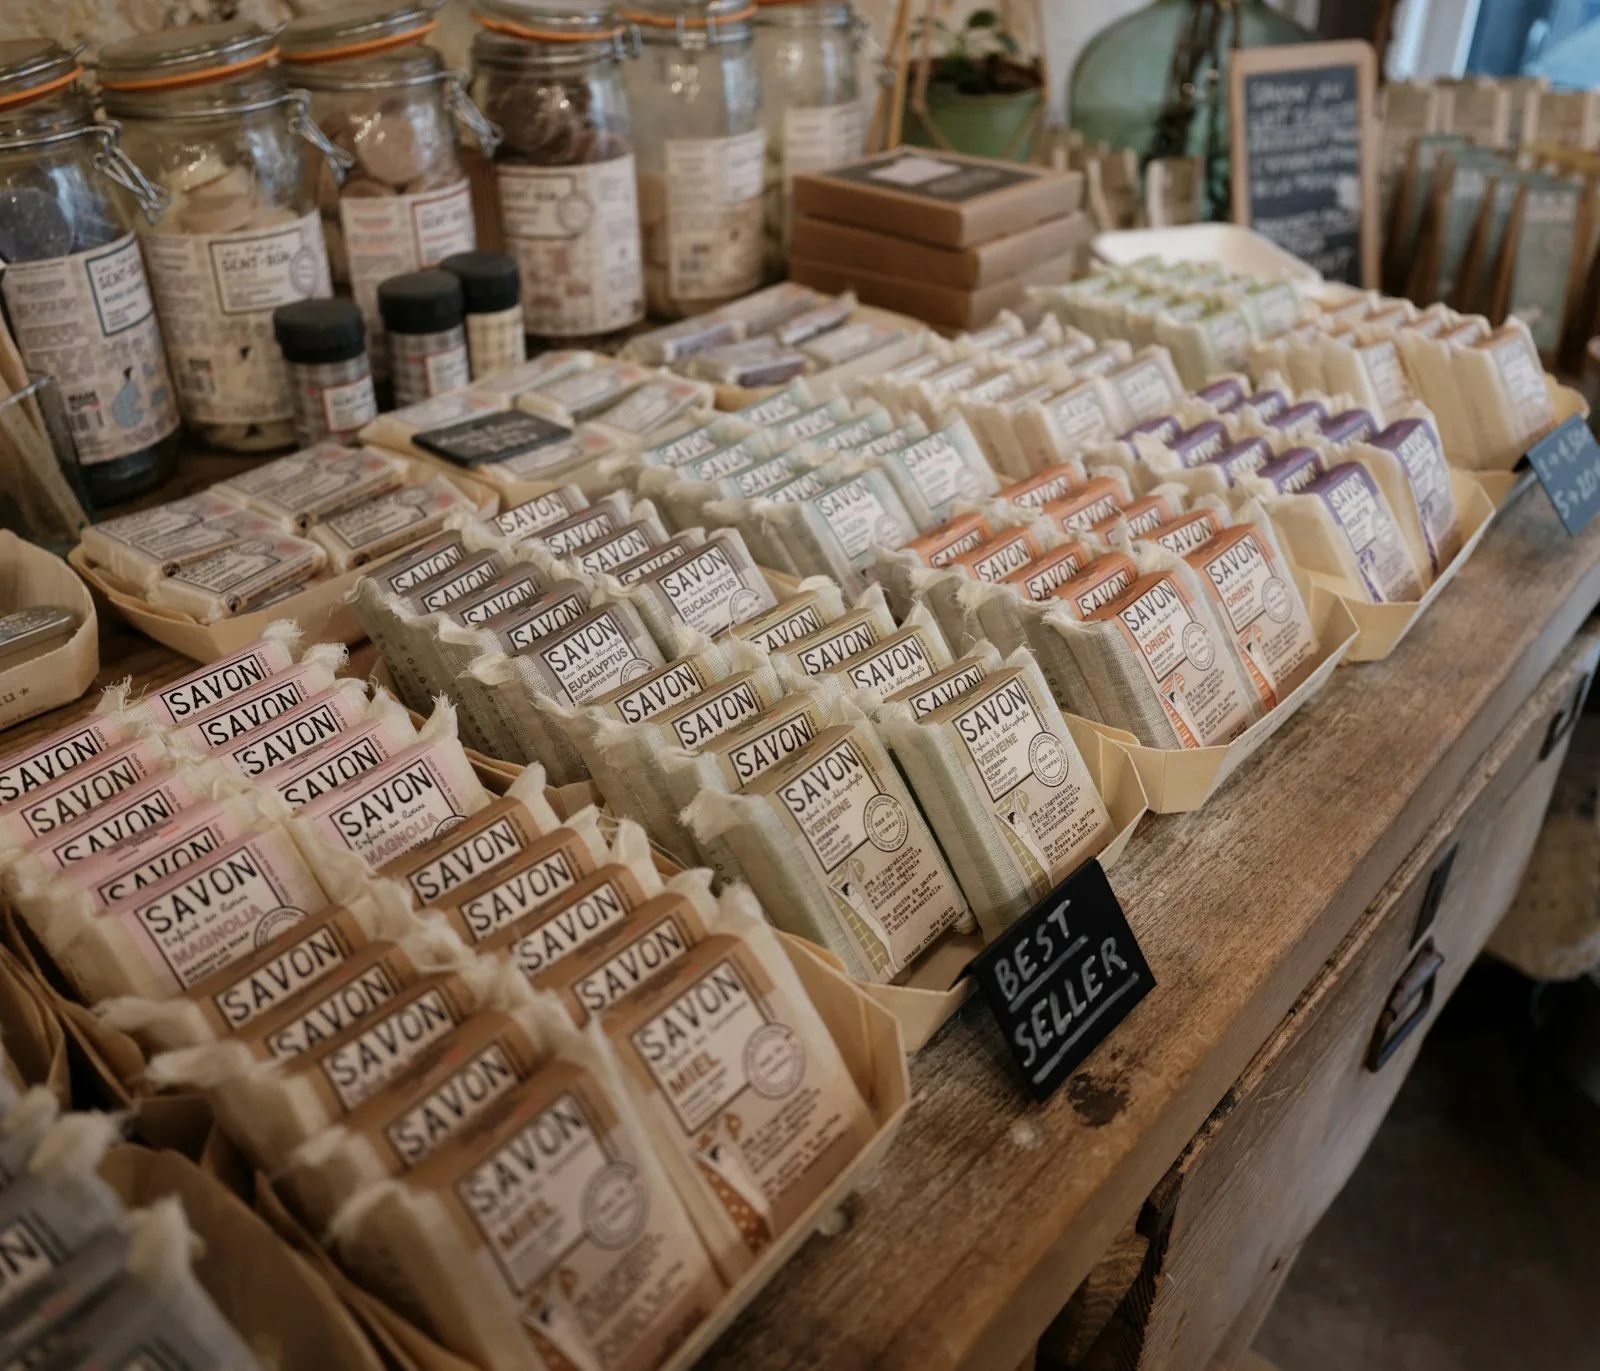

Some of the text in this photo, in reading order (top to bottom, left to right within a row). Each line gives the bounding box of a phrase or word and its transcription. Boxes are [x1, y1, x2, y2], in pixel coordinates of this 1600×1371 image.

[903, 432, 951, 468] SAVON
[739, 458, 790, 494] SAVON
[819, 477, 870, 517] SAVON
[1328, 472, 1367, 511] SAVON
[499, 493, 564, 533] SAVON
[549, 517, 614, 556] SAVON
[1066, 501, 1117, 532] SAVON
[1162, 519, 1213, 554] SAVON
[582, 530, 647, 575] SAVON
[663, 550, 728, 598] SAVON
[978, 541, 1029, 583] SAVON
[1209, 538, 1260, 586] SAVON
[681, 578, 738, 618] EUCALYPTUS
[1029, 558, 1079, 601] SAVON
[1080, 572, 1130, 617] SAVON
[1227, 579, 1255, 607] ORIENT
[514, 602, 583, 645] SAVON
[1123, 581, 1176, 632] SAVON
[548, 617, 618, 672] SAVON
[754, 611, 818, 653] AVON
[805, 627, 873, 675] SAVON
[1144, 624, 1174, 655] ORIENT
[169, 660, 261, 715] SAVON
[567, 647, 628, 694] EUCALYPTUS
[574, 666, 620, 701] EUCALYPTUS SOAP
[855, 640, 923, 690] SAVON
[207, 687, 297, 746] SAVON
[623, 665, 696, 724] SAVON
[680, 687, 755, 747] SAVON
[959, 683, 1026, 743] SAVON
[242, 710, 336, 775] SAVON
[736, 719, 812, 778] SAVON
[977, 733, 1018, 767] VERVEINE
[983, 756, 1008, 775] VERBENA
[1038, 748, 1056, 763] mas du
[1042, 757, 1061, 773] roseau
[0, 735, 96, 802] SAVON
[284, 744, 378, 805] SAVON
[784, 745, 860, 813] SAVON
[987, 769, 1002, 782] SOAP
[31, 763, 136, 834] SAVON
[338, 766, 433, 837] SAVON
[807, 798, 852, 838] VERVEINE
[874, 810, 894, 828] mas du
[1057, 786, 1081, 807] naturelle
[64, 797, 170, 861] SAVON
[355, 829, 387, 850] Infusé
[389, 818, 400, 829] au
[364, 812, 440, 866] MAGNOLIA
[814, 824, 840, 846] VERBENA
[818, 836, 834, 852] SOAP
[1042, 815, 1057, 828] huile
[1043, 844, 1053, 853] Une
[1079, 808, 1095, 826] parfum
[416, 824, 516, 900] SAVON
[145, 854, 257, 934] SAVON
[468, 857, 571, 933] SAVON
[172, 903, 265, 966] MAGNOLIA
[228, 931, 250, 951] SOAP
[518, 888, 620, 971] SAVON
[993, 899, 1072, 1001] BEST
[224, 933, 338, 1022] SAVON
[581, 924, 683, 1011] SAVON
[276, 970, 390, 1053] SAVON
[640, 967, 743, 1062] SAVON
[1014, 936, 1128, 1067] SELLER
[331, 995, 447, 1087] SAVON
[667, 1052, 723, 1097] MIEL
[396, 1052, 509, 1158] SAVON
[467, 1100, 583, 1214] SAVON
